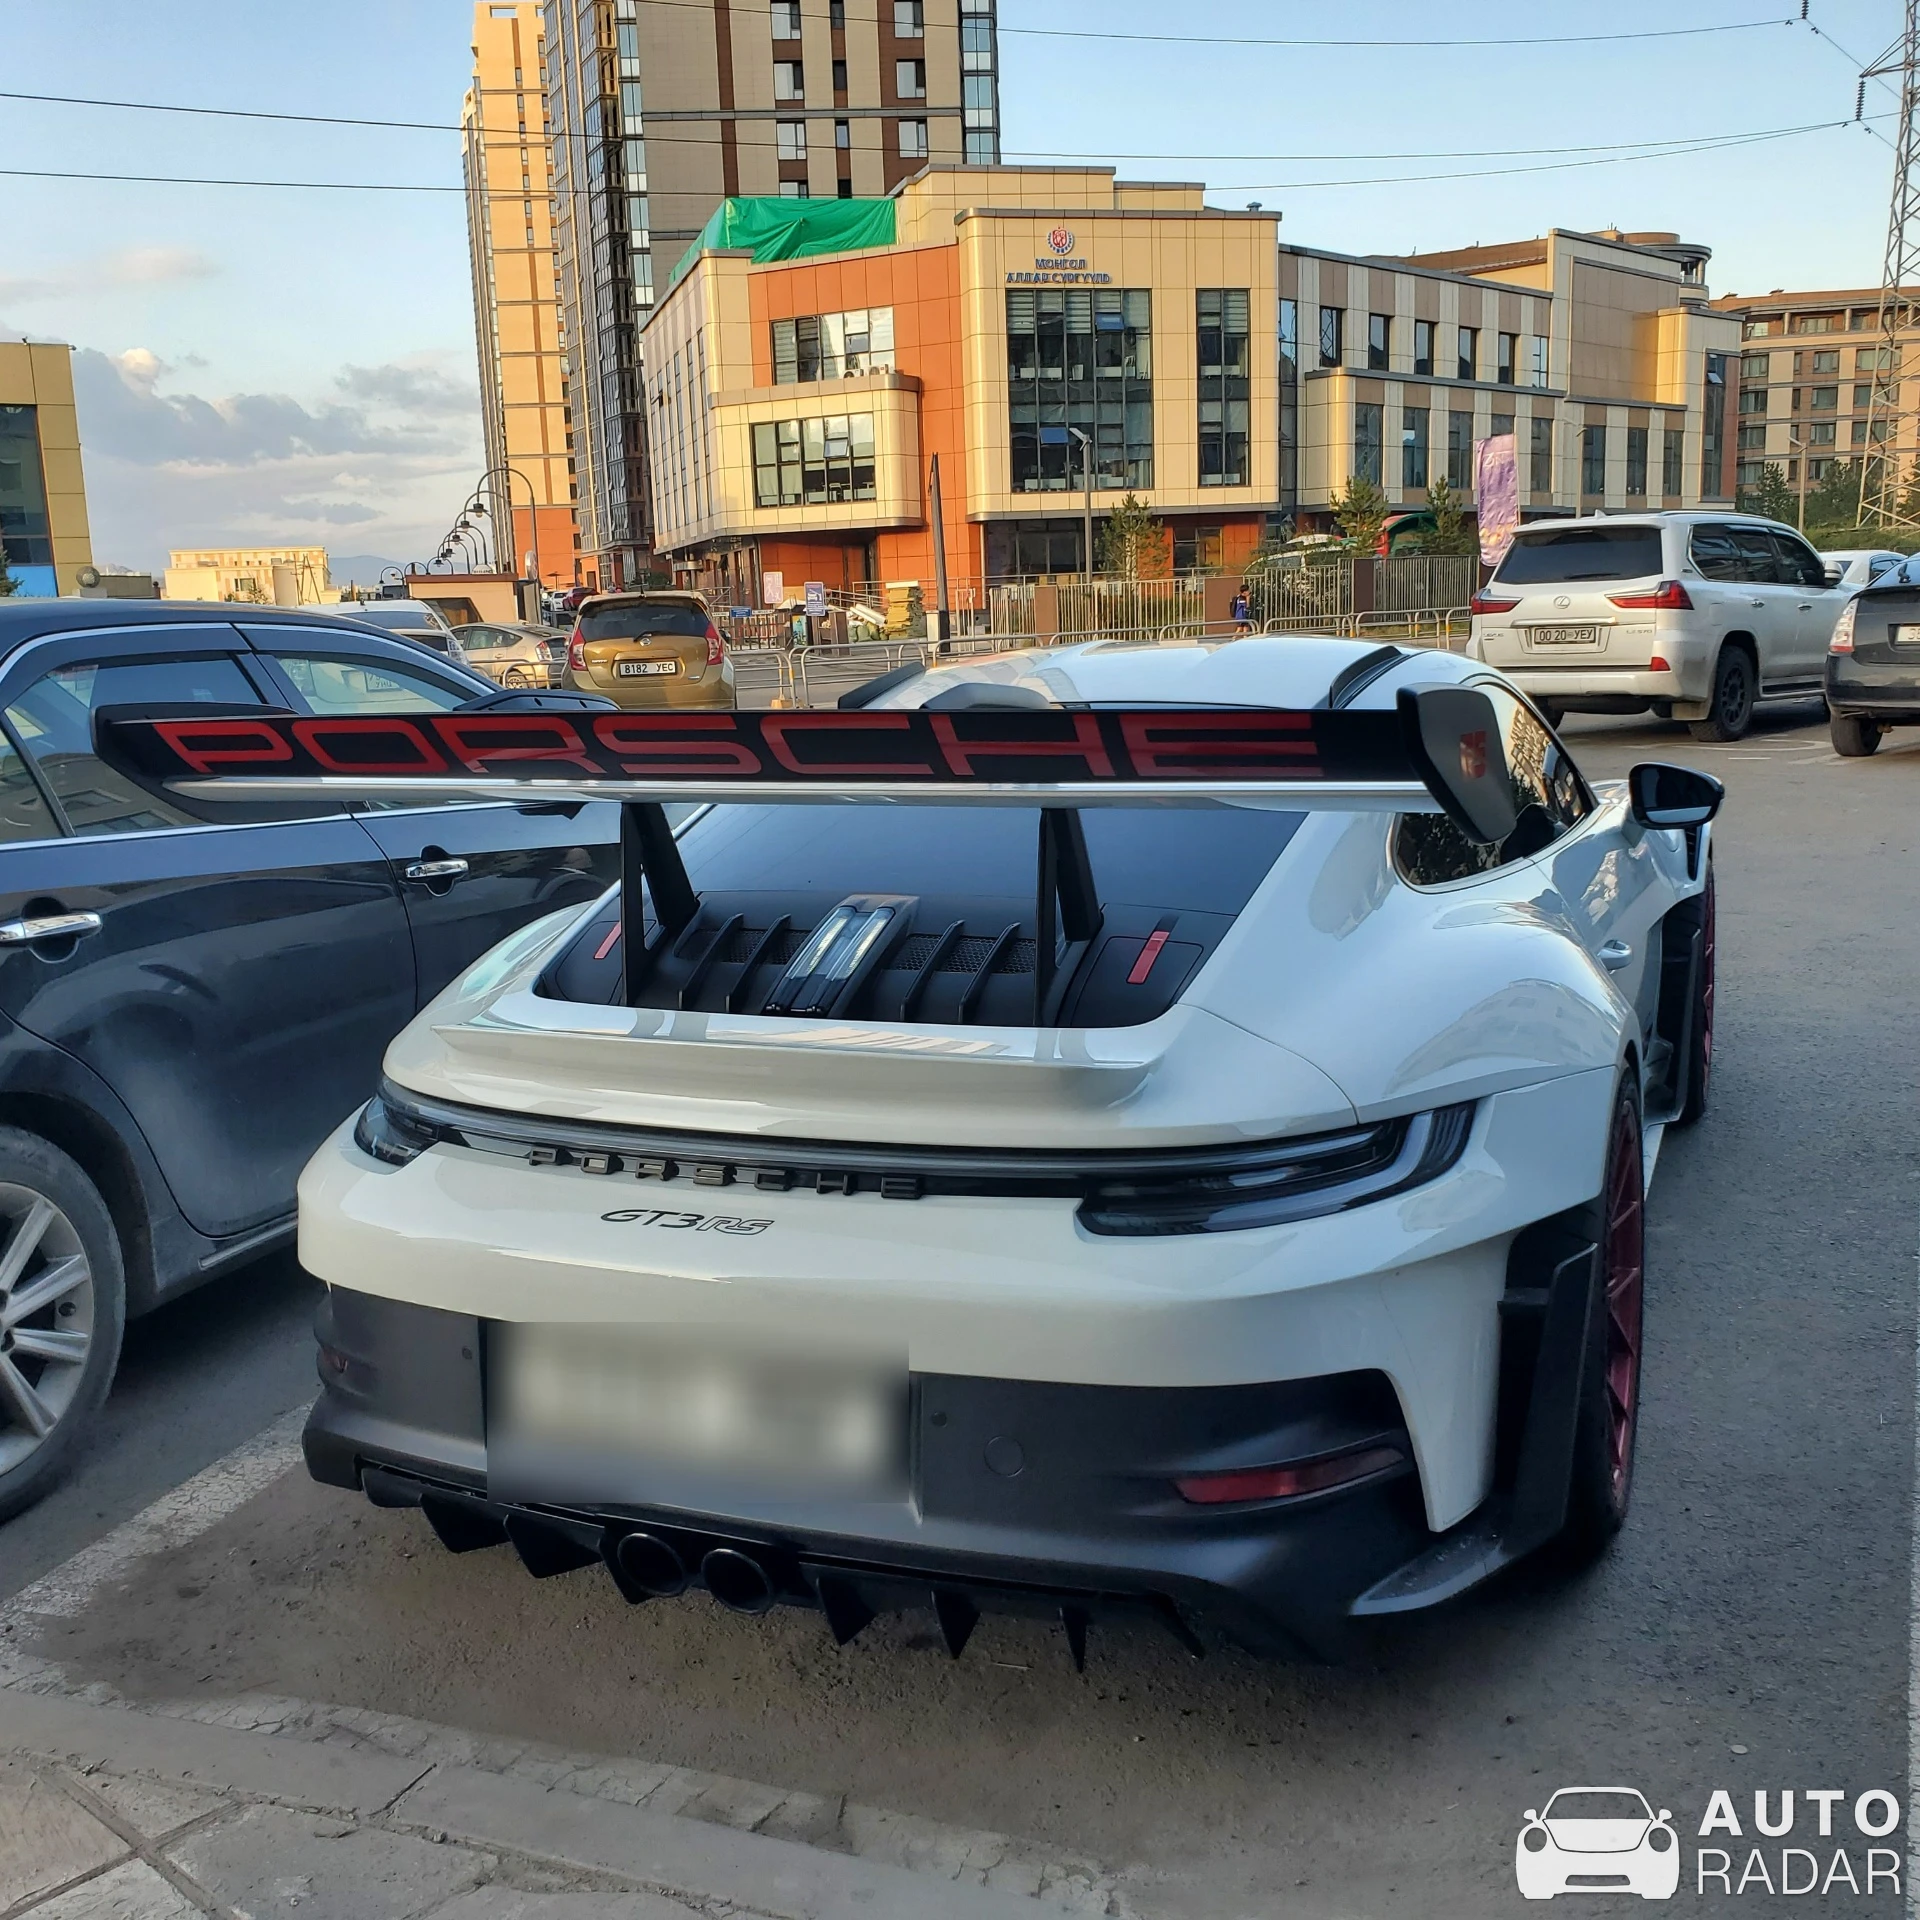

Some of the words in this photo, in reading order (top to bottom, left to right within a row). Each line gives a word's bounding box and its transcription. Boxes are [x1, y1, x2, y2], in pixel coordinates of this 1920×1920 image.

[1035, 258, 1087, 270] МОНГОЛ
[1574, 628, 1593, 640] УЕУ
[624, 663, 649, 674] 8182
[656, 663, 674, 672] УЕС
[152, 714, 1323, 777] PORSCHE
[529, 1146, 922, 1200] PORSCHE
